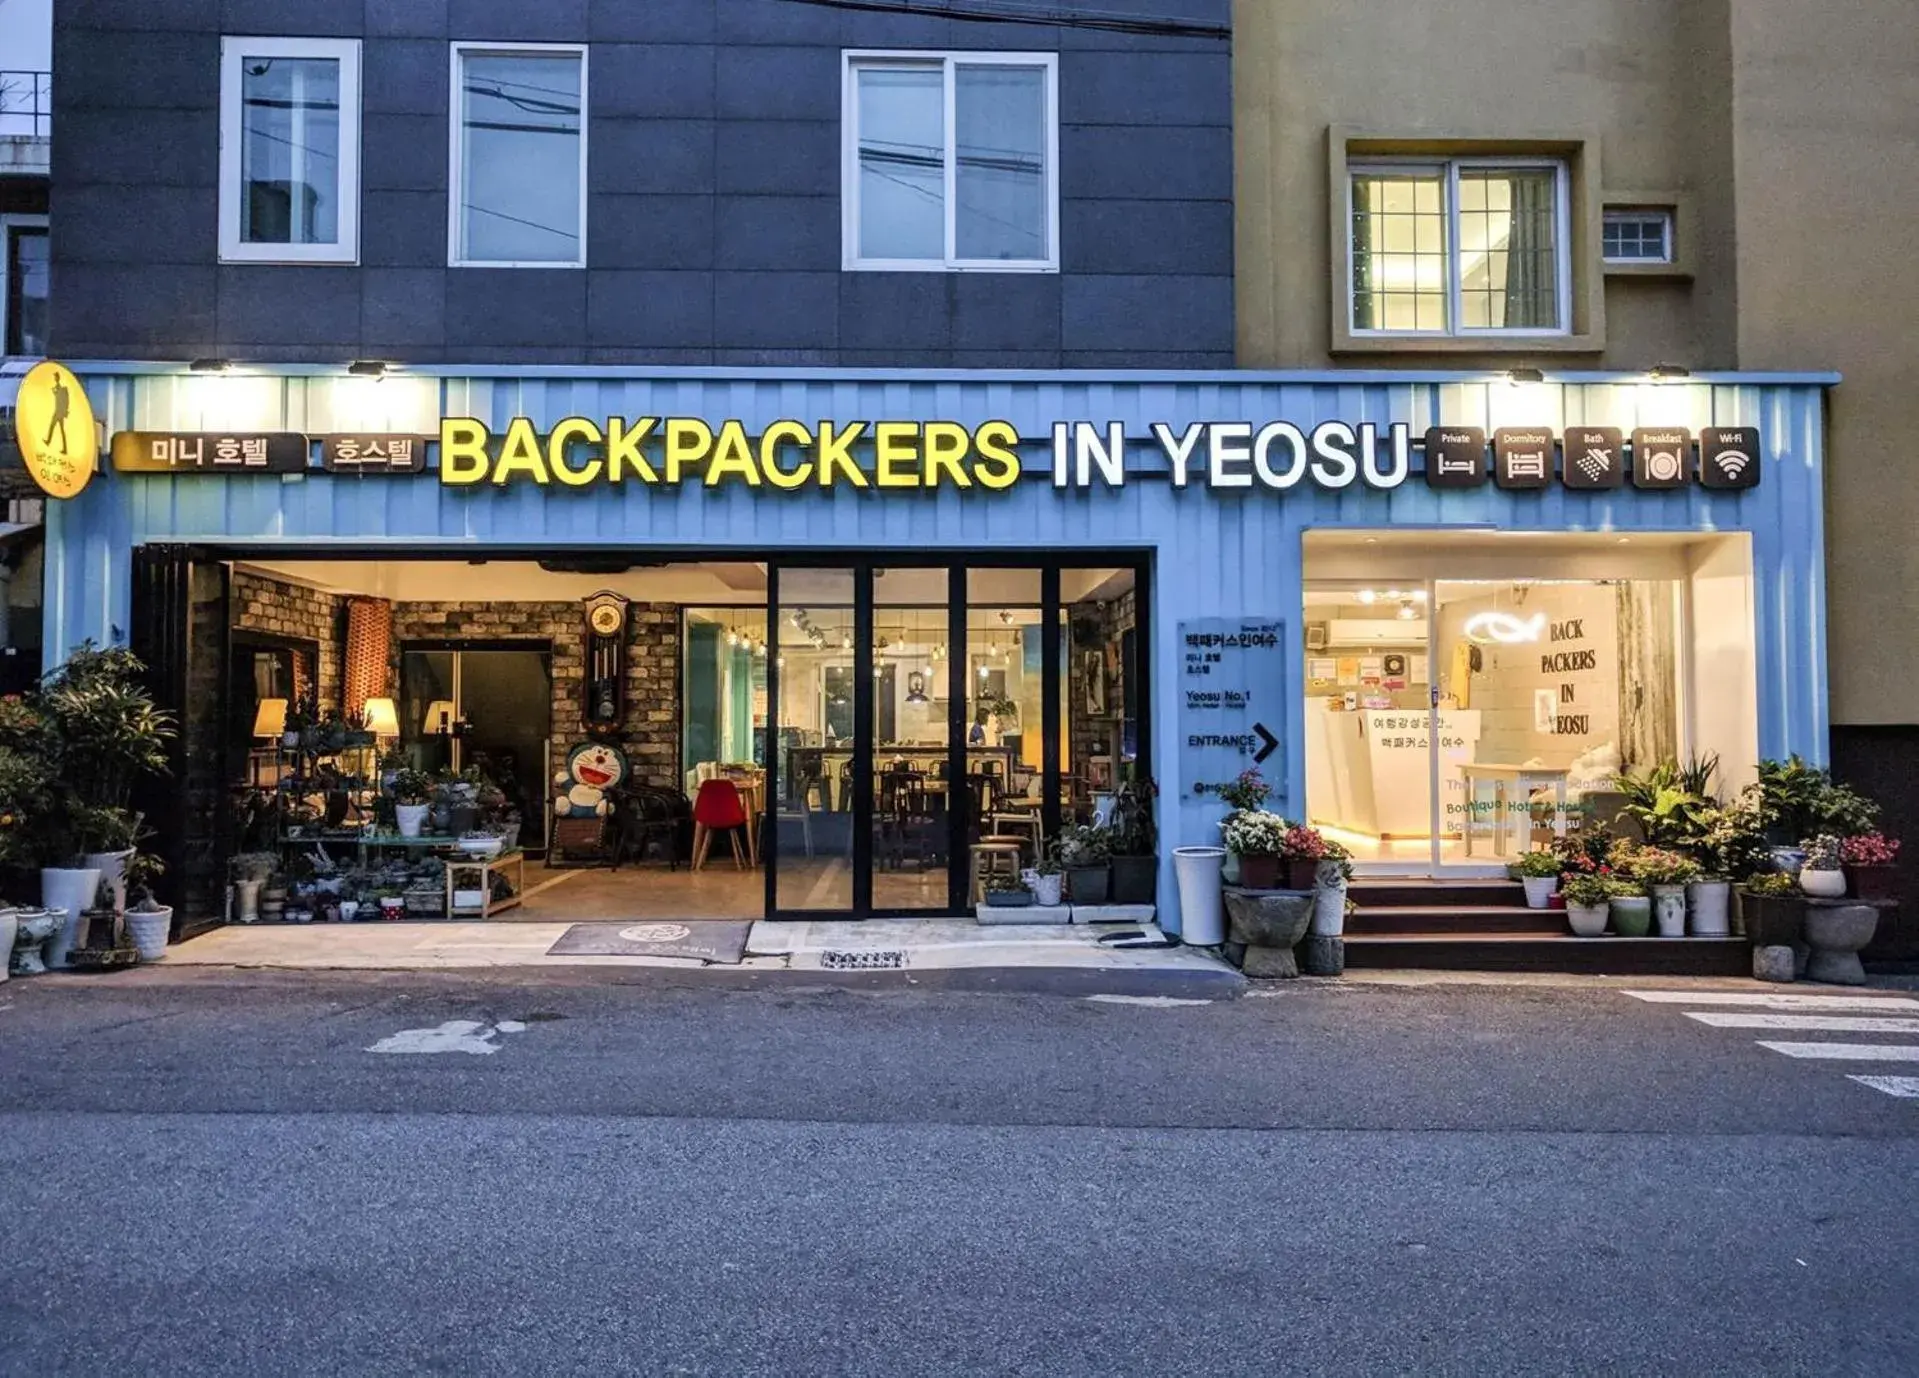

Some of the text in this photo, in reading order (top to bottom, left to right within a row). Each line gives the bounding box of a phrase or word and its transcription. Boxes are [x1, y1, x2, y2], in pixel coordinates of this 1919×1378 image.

[1441, 433, 1471, 444] Private
[1503, 433, 1546, 445] Dormitory
[1584, 433, 1604, 444] Bath
[1643, 433, 1682, 444] Breakfast
[151, 438, 268, 466] 미니 호텔
[333, 439, 412, 466] 호스텔
[439, 416, 1410, 490] BACKPACKERS IN YEOSU
[1550, 619, 1584, 642] BACK
[1541, 649, 1596, 674] PACKERS
[1185, 690, 1220, 701] Yeosu
[1560, 684, 1575, 703] IN
[1188, 735, 1256, 747] ENTRANCE
